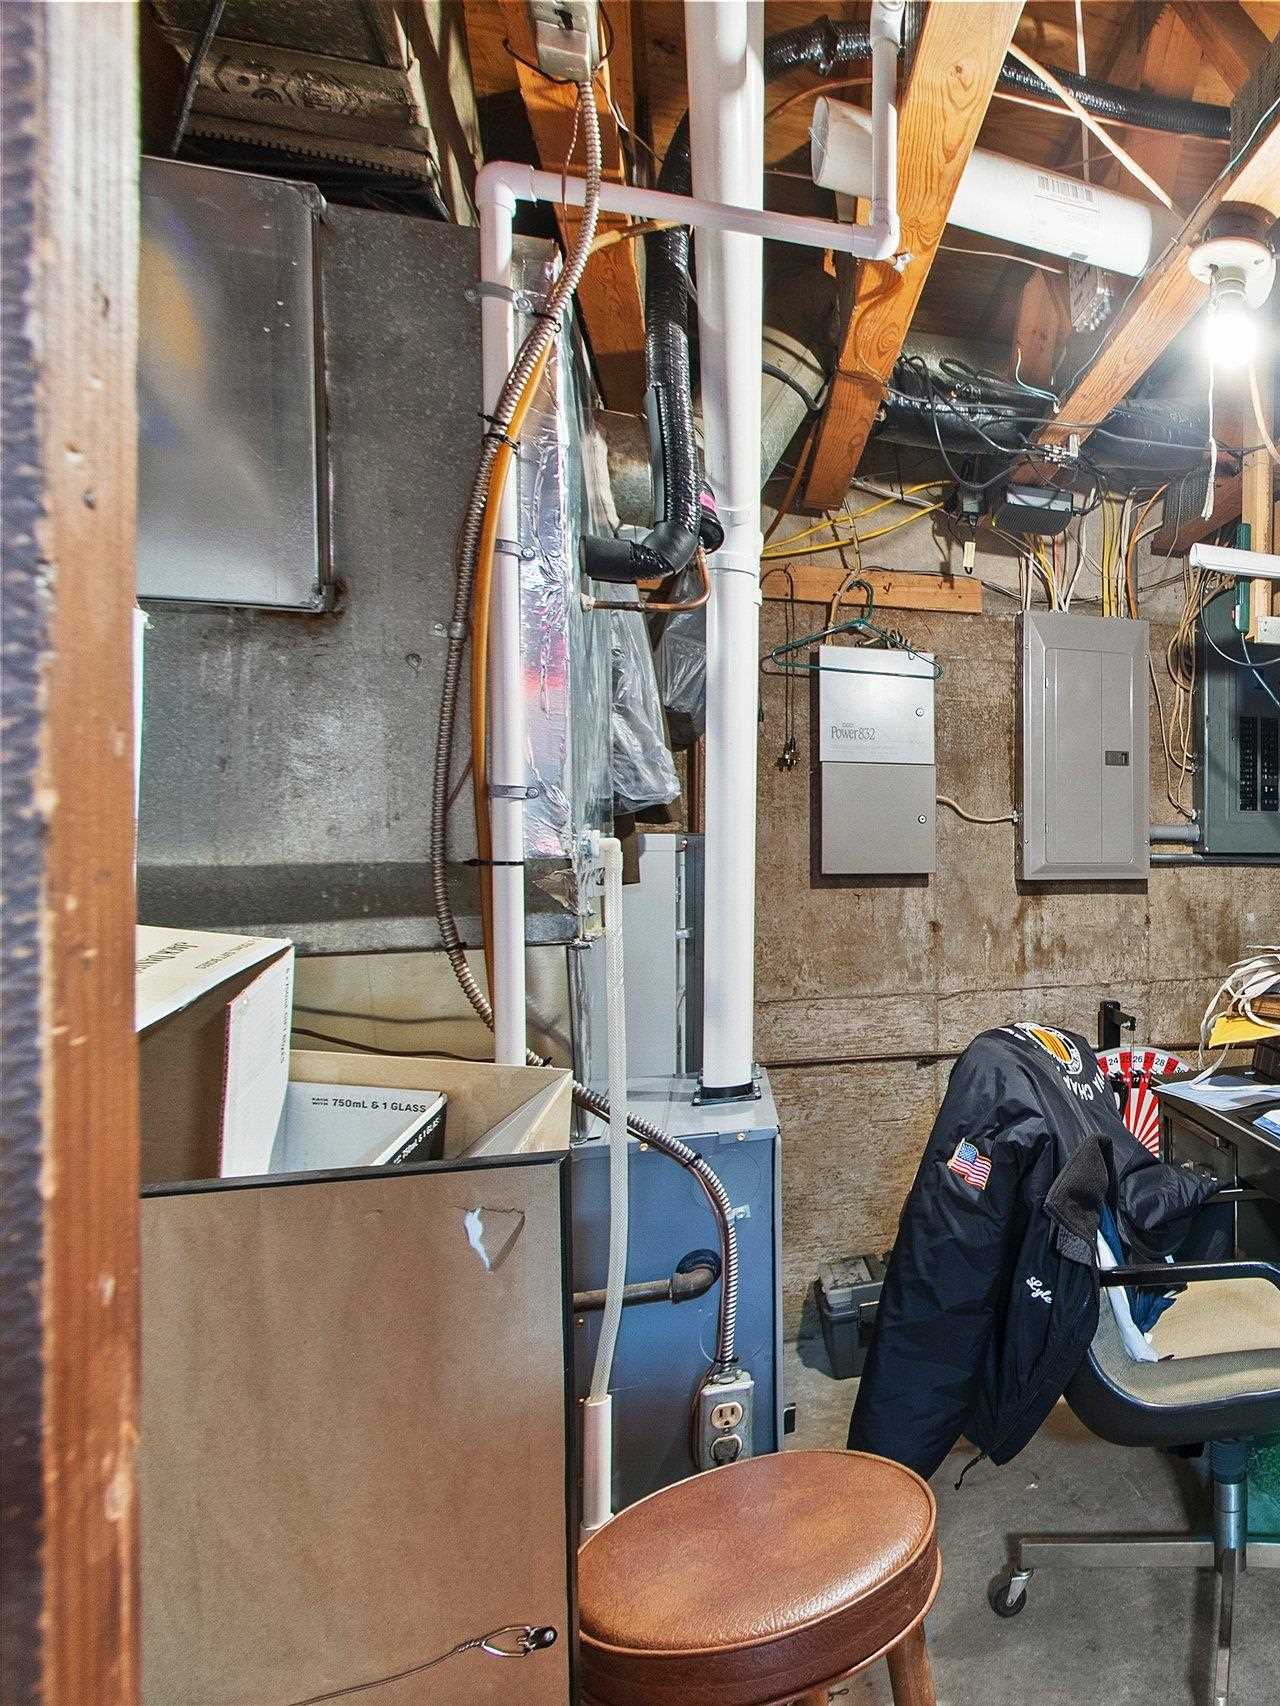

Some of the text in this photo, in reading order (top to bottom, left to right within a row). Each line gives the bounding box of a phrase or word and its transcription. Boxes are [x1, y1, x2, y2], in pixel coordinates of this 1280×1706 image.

[831, 725, 876, 740] Power832
[1108, 1057, 1119, 1065] 24
[1133, 1055, 1143, 1063] 26
[1154, 1058, 1166, 1067] 28
[332, 1098, 368, 1109] 750mL
[371, 1101, 380, 1109] &
[390, 1102, 427, 1113] GLASS
[1026, 1276, 1053, 1304] Lyle
